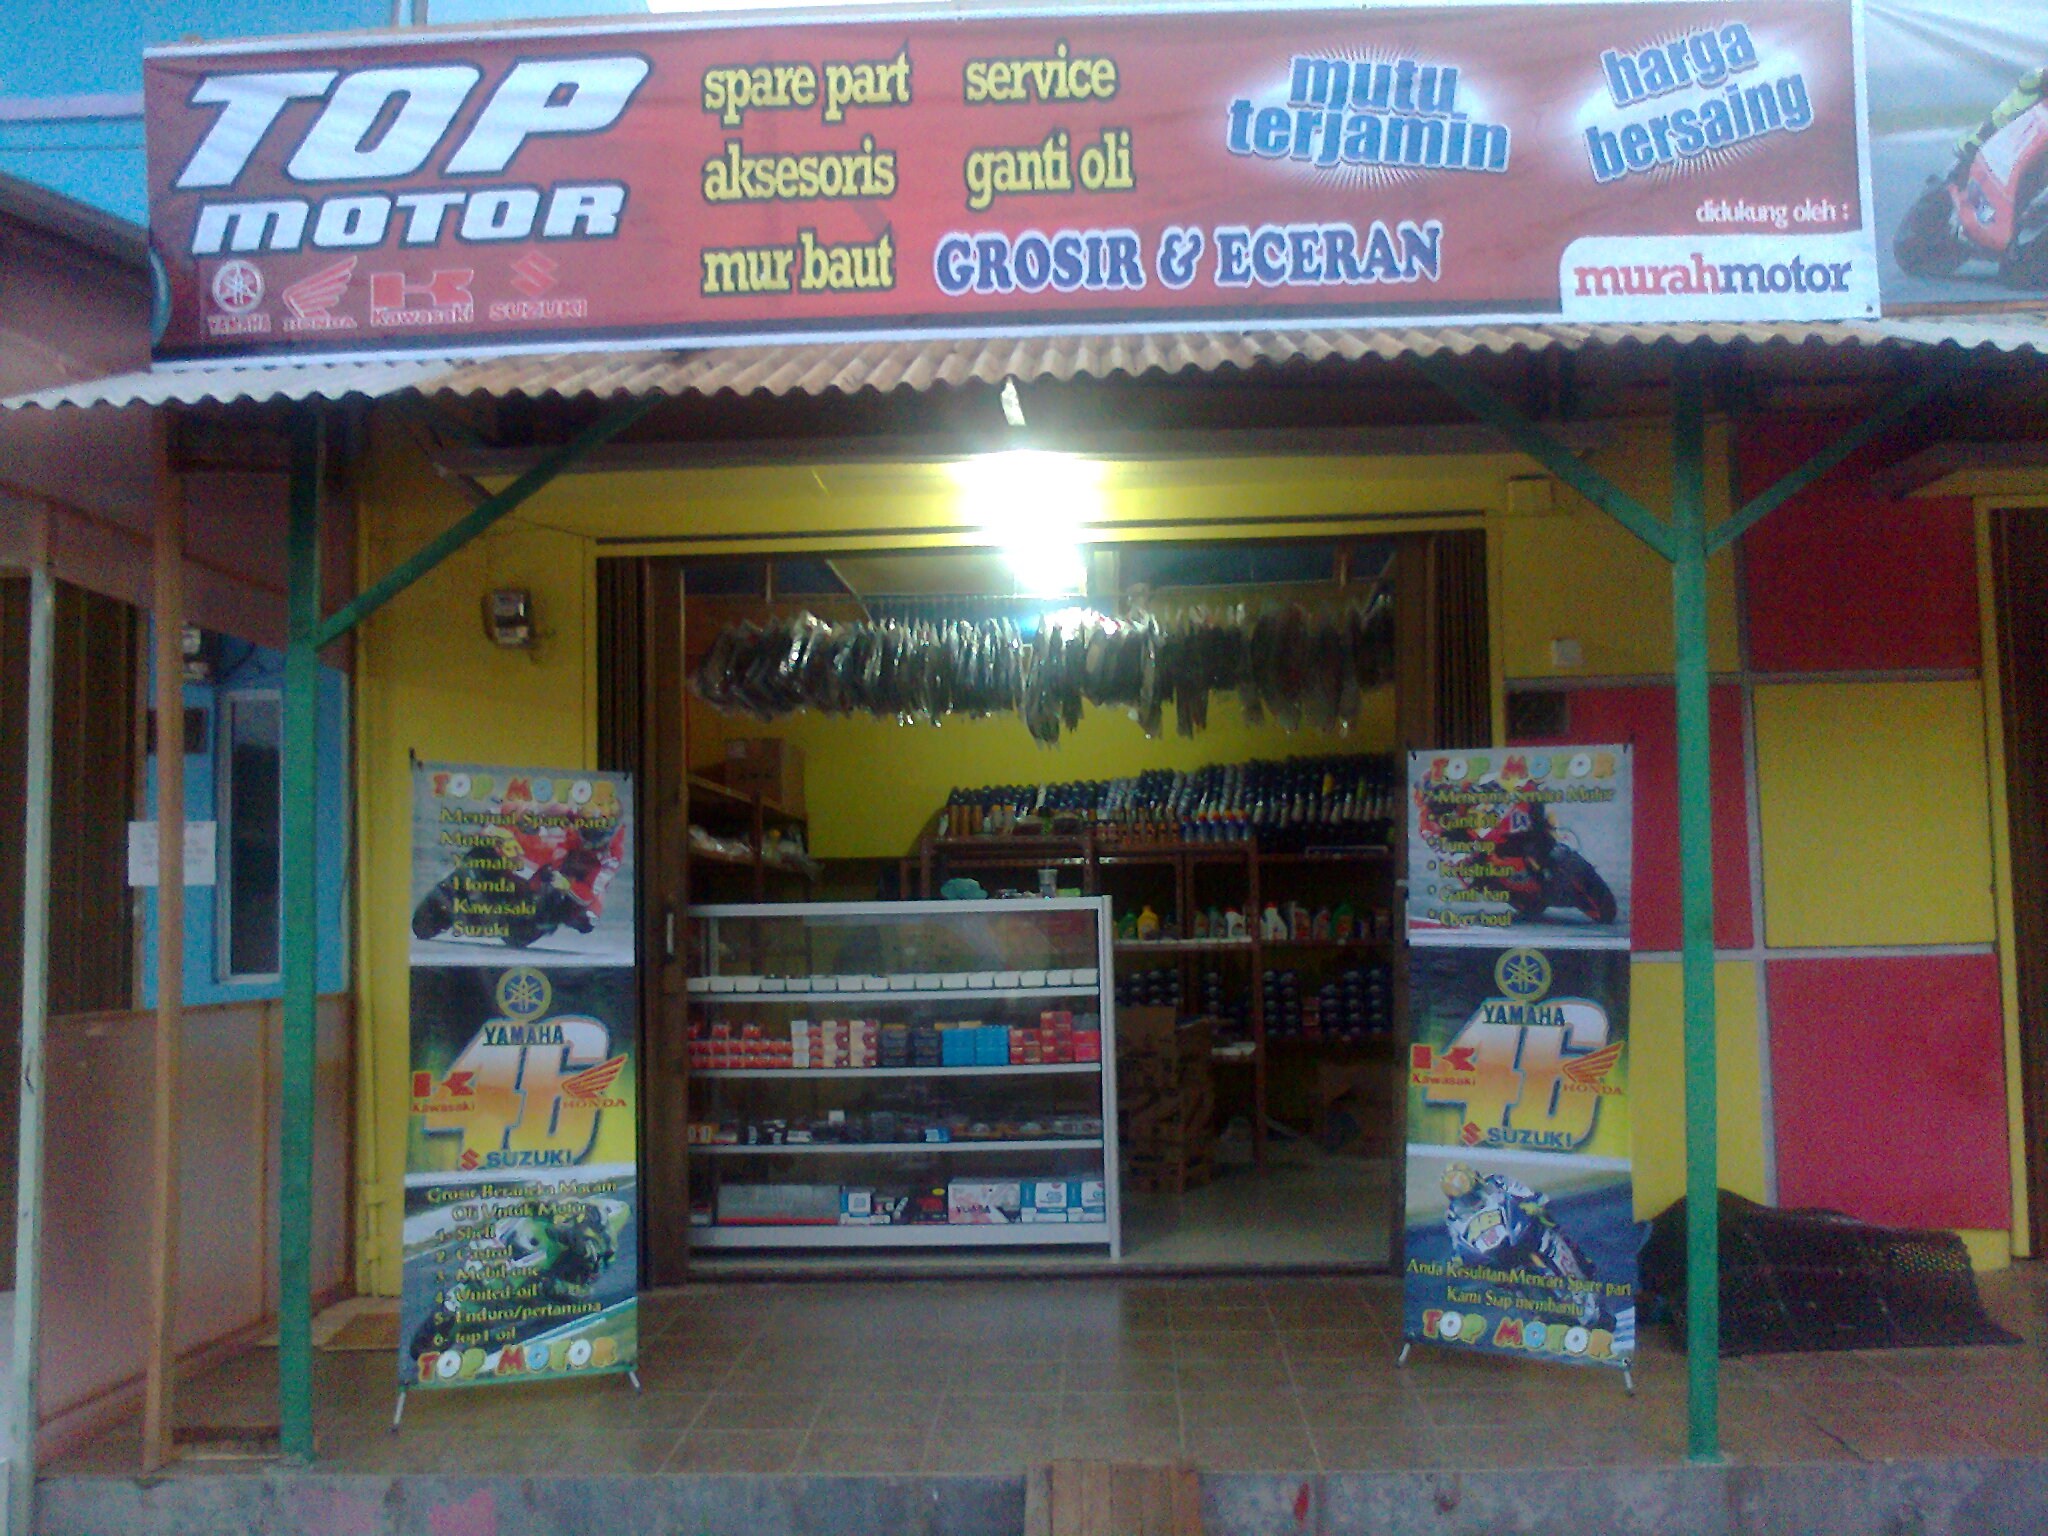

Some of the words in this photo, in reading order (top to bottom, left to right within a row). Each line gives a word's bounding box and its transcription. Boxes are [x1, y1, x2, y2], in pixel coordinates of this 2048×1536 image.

[965, 45, 1116, 100] service
[1603, 22, 1757, 105] harga
[704, 60, 815, 124] spare
[825, 53, 911, 121] part
[1290, 55, 1460, 114] mutu
[174, 56, 650, 188] TOP
[1229, 98, 1508, 172] terjamin
[1585, 74, 1812, 181] bersaing
[703, 138, 896, 199] aksesoris
[967, 134, 1070, 210] ganti
[1080, 132, 1134, 190] oli
[1696, 198, 1788, 229] didukung
[703, 246, 791, 293] mur
[800, 231, 893, 290] baut
[935, 231, 1144, 294] GROSIR
[1157, 226, 1204, 289] &
[1216, 222, 1442, 286] ECERAN
[1573, 252, 1852, 298] murahmotor
[489, 299, 588, 321] SUZUKI
[1431, 757, 1490, 783] TOP
[1501, 753, 1616, 780] MOTOR
[433, 773, 494, 797] TOP
[506, 775, 615, 803] MOTOR
[453, 854, 524, 871] Yamaha
[453, 877, 516, 893] Honda
[453, 899, 537, 916] Kawasaki
[453, 921, 510, 938] Suzuki
[1482, 1005, 1567, 1026] YAMAHA
[483, 1024, 566, 1045] YAMAHA
[1411, 1073, 1476, 1086] Kawasaki
[1563, 1084, 1624, 1096] HONDA
[411, 1102, 476, 1113] Kawasaki
[563, 1098, 627, 1109] HONDA
[1486, 1128, 1572, 1147] SUZUKI
[485, 1150, 573, 1167] SUZUKI
[1423, 1309, 1487, 1344] TOP
[1493, 1316, 1618, 1359] MOTOR
[418, 1347, 487, 1382] TOP
[495, 1336, 618, 1376] MOTOR
